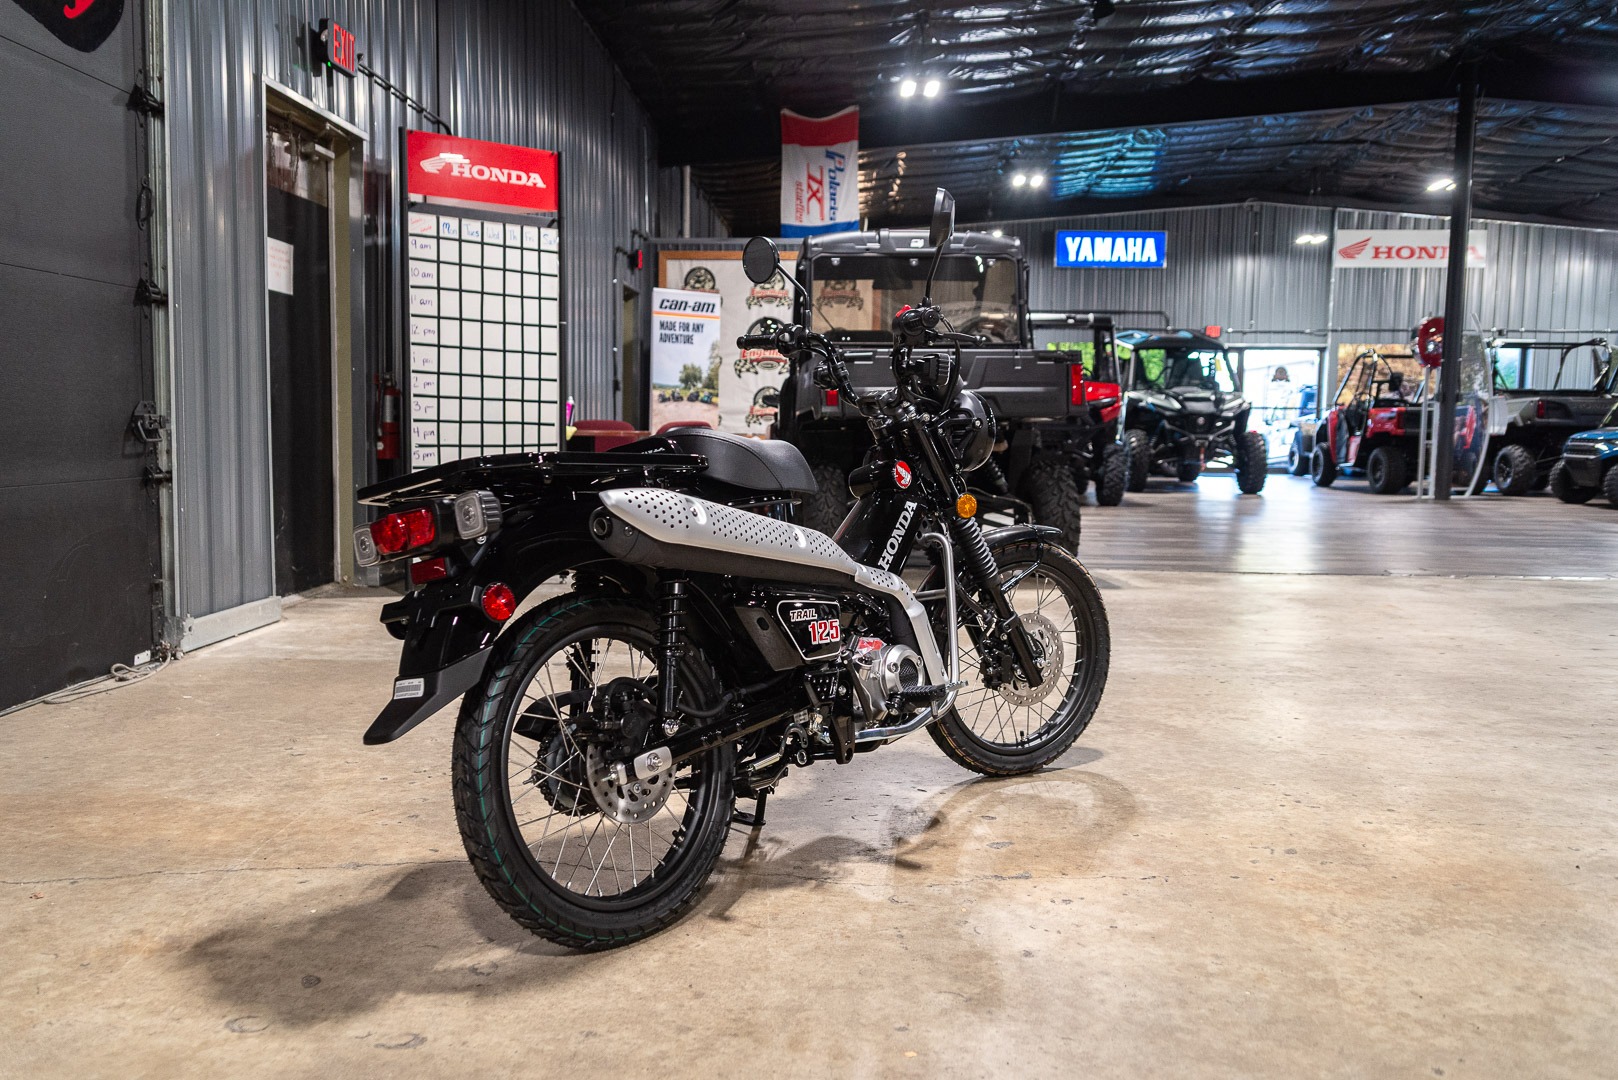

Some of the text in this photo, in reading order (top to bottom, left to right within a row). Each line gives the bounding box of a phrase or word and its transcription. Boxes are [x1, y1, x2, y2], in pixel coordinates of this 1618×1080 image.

[333, 22, 355, 73] EXIT
[451, 163, 546, 189] HONDA
[825, 149, 845, 222] Polaris
[442, 222, 457, 235] Mon
[464, 223, 480, 238] Tues
[411, 239, 418, 250] 9
[1065, 236, 1157, 262] YAMAHA
[410, 267, 420, 277] 10
[658, 298, 716, 313] can-am
[659, 320, 704, 334] MADE FOR ANY
[659, 333, 694, 345] ADVENTURE
[413, 401, 421, 412] 3
[413, 426, 420, 437] 4
[413, 450, 421, 460] 5
[878, 500, 918, 571] HONDA
[790, 608, 817, 622] TRAIL
[808, 618, 841, 645] 125
